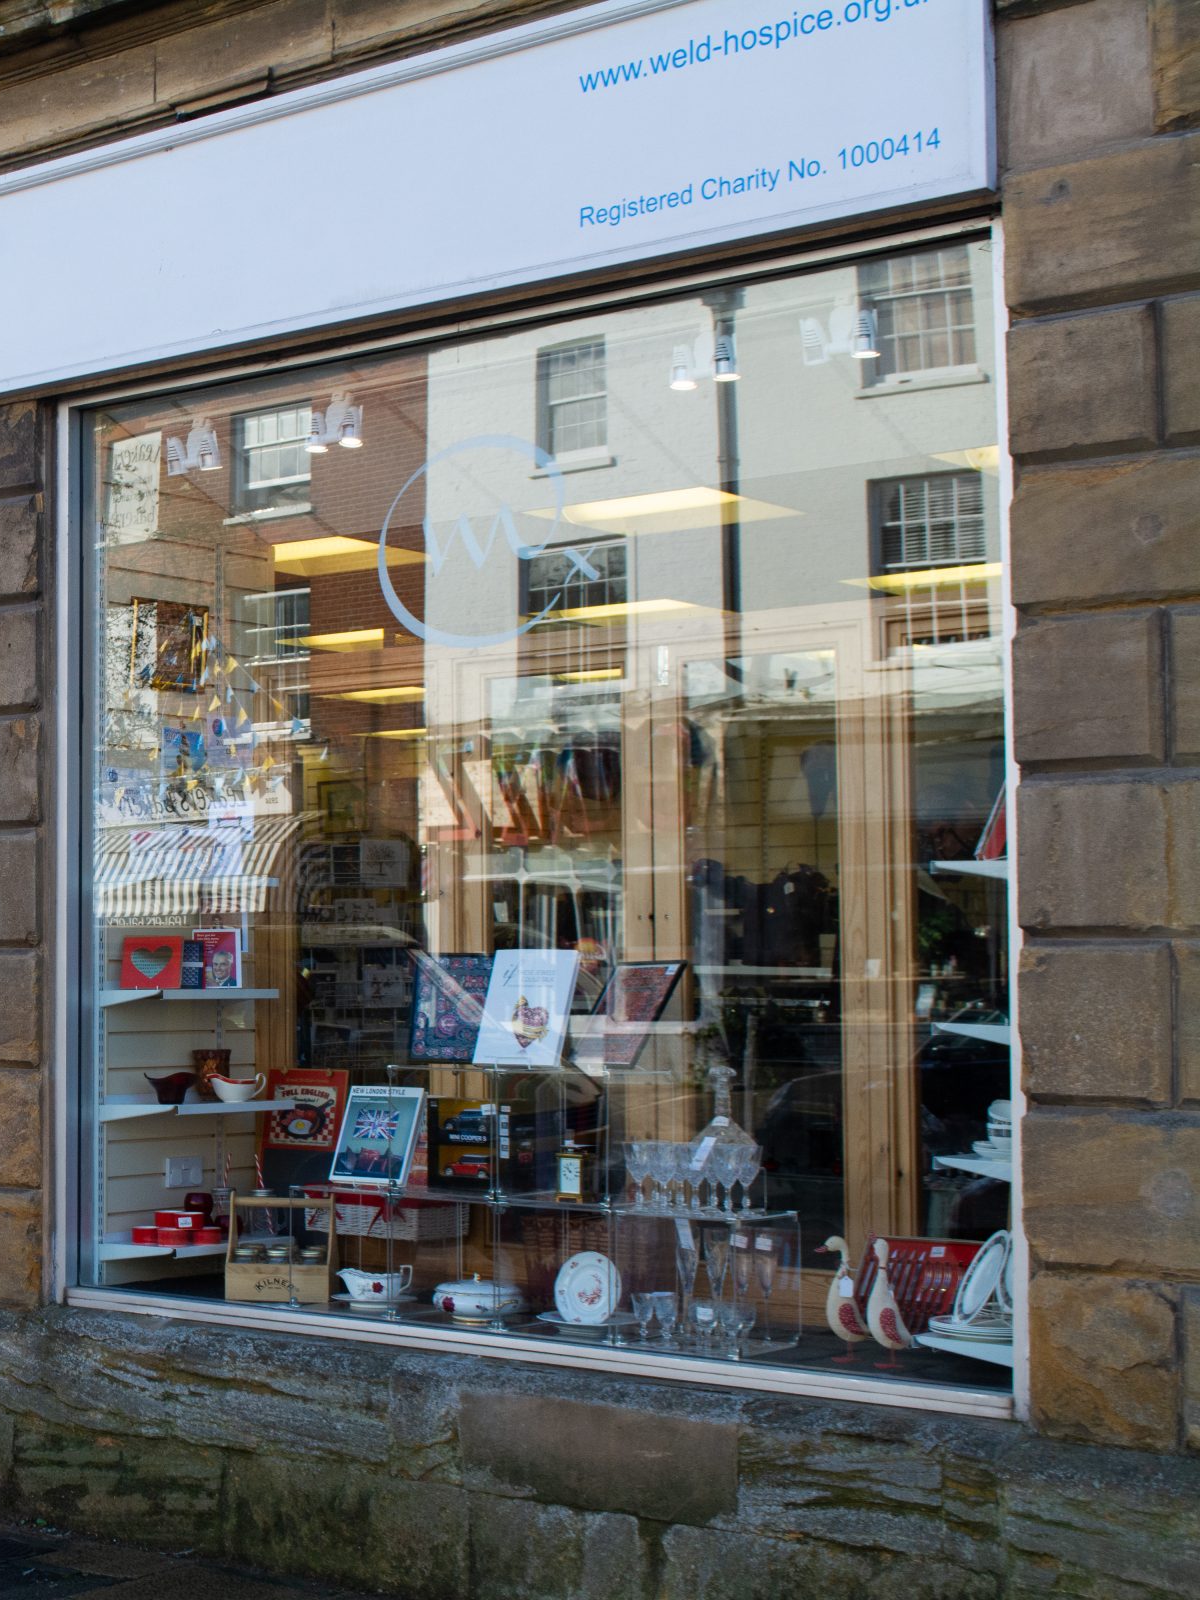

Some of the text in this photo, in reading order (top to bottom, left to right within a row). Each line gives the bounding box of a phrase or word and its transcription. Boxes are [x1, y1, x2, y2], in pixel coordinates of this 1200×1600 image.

[579, 0, 928, 93] www.weld-hospice.org.
[579, 127, 941, 227] Registered Charity No. 1000414
[351, 1087, 365, 1095] NEW
[365, 1087, 387, 1095] LONDON
